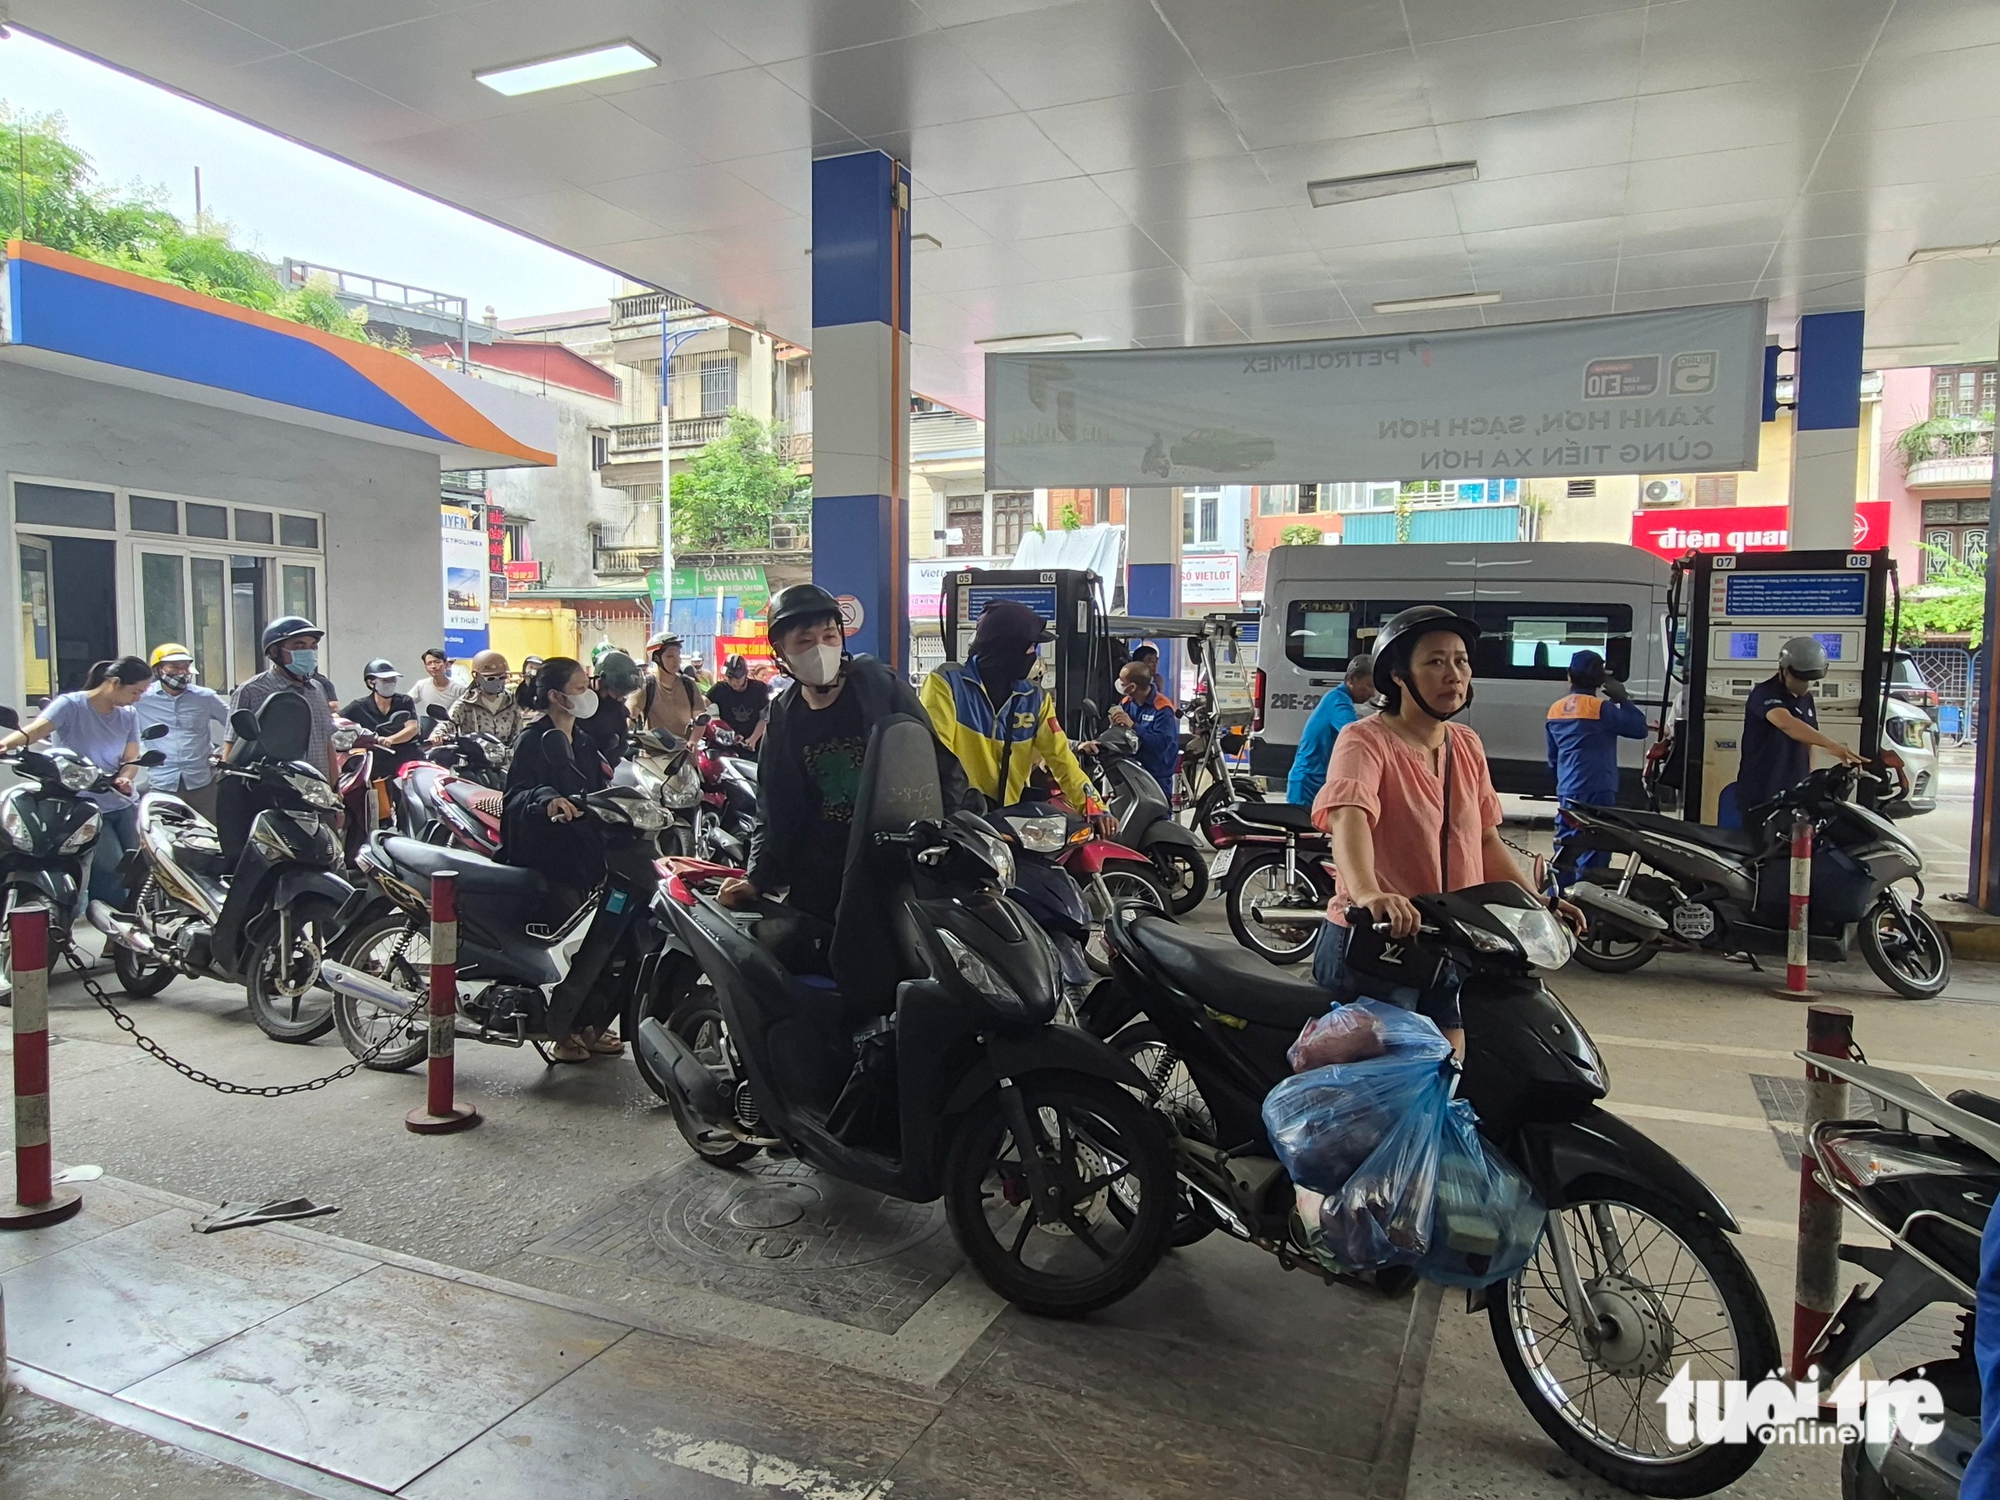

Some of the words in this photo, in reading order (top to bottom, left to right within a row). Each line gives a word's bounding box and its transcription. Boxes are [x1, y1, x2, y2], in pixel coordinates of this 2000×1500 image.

[1716, 557, 1733, 567] 07
[1850, 556, 1867, 566] 08
[703, 566, 740, 582] BÁNH
[742, 566, 758, 581] MÌ
[959, 574, 970, 583] 05
[1042, 573, 1054, 582] 06
[1195, 570, 1231, 581] VIETLOT
